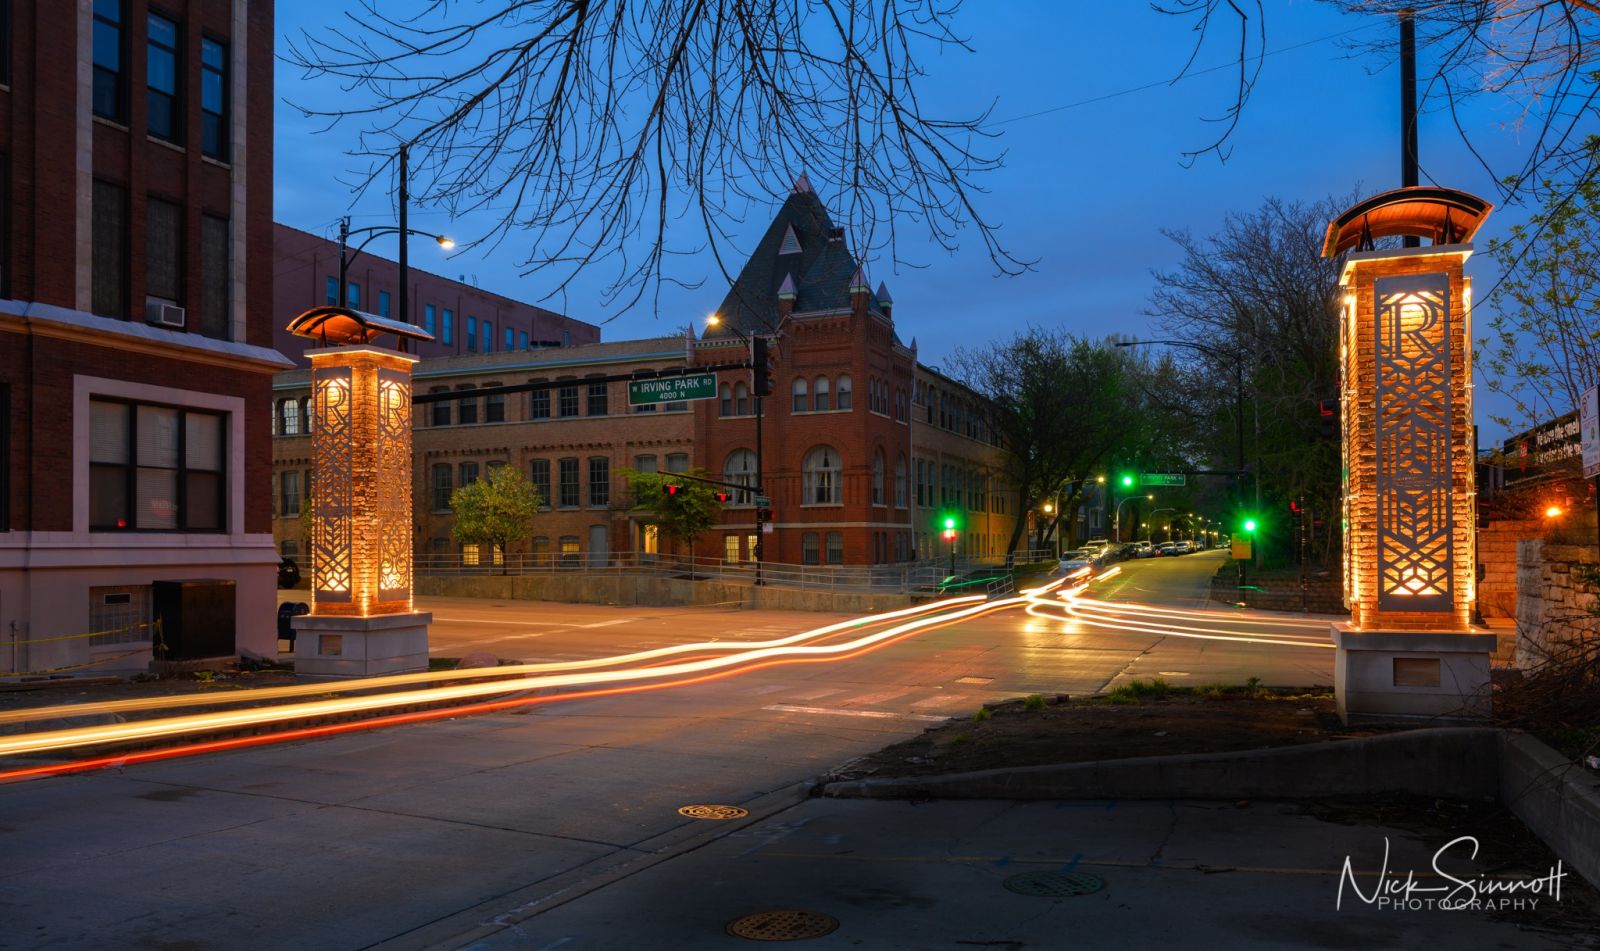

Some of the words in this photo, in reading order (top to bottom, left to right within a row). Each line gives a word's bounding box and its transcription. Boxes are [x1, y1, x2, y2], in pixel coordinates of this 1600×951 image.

[1388, 302, 1438, 359] R
[641, 381, 671, 393] IRVING
[675, 378, 699, 390] PARK
[703, 378, 712, 386] RD
[660, 392, 677, 400] 4000
[322, 385, 346, 427] R
[384, 387, 405, 429] R
[1555, 423, 1564, 439] the
[1564, 418, 1579, 437] smell
[1563, 441, 1573, 458] the
